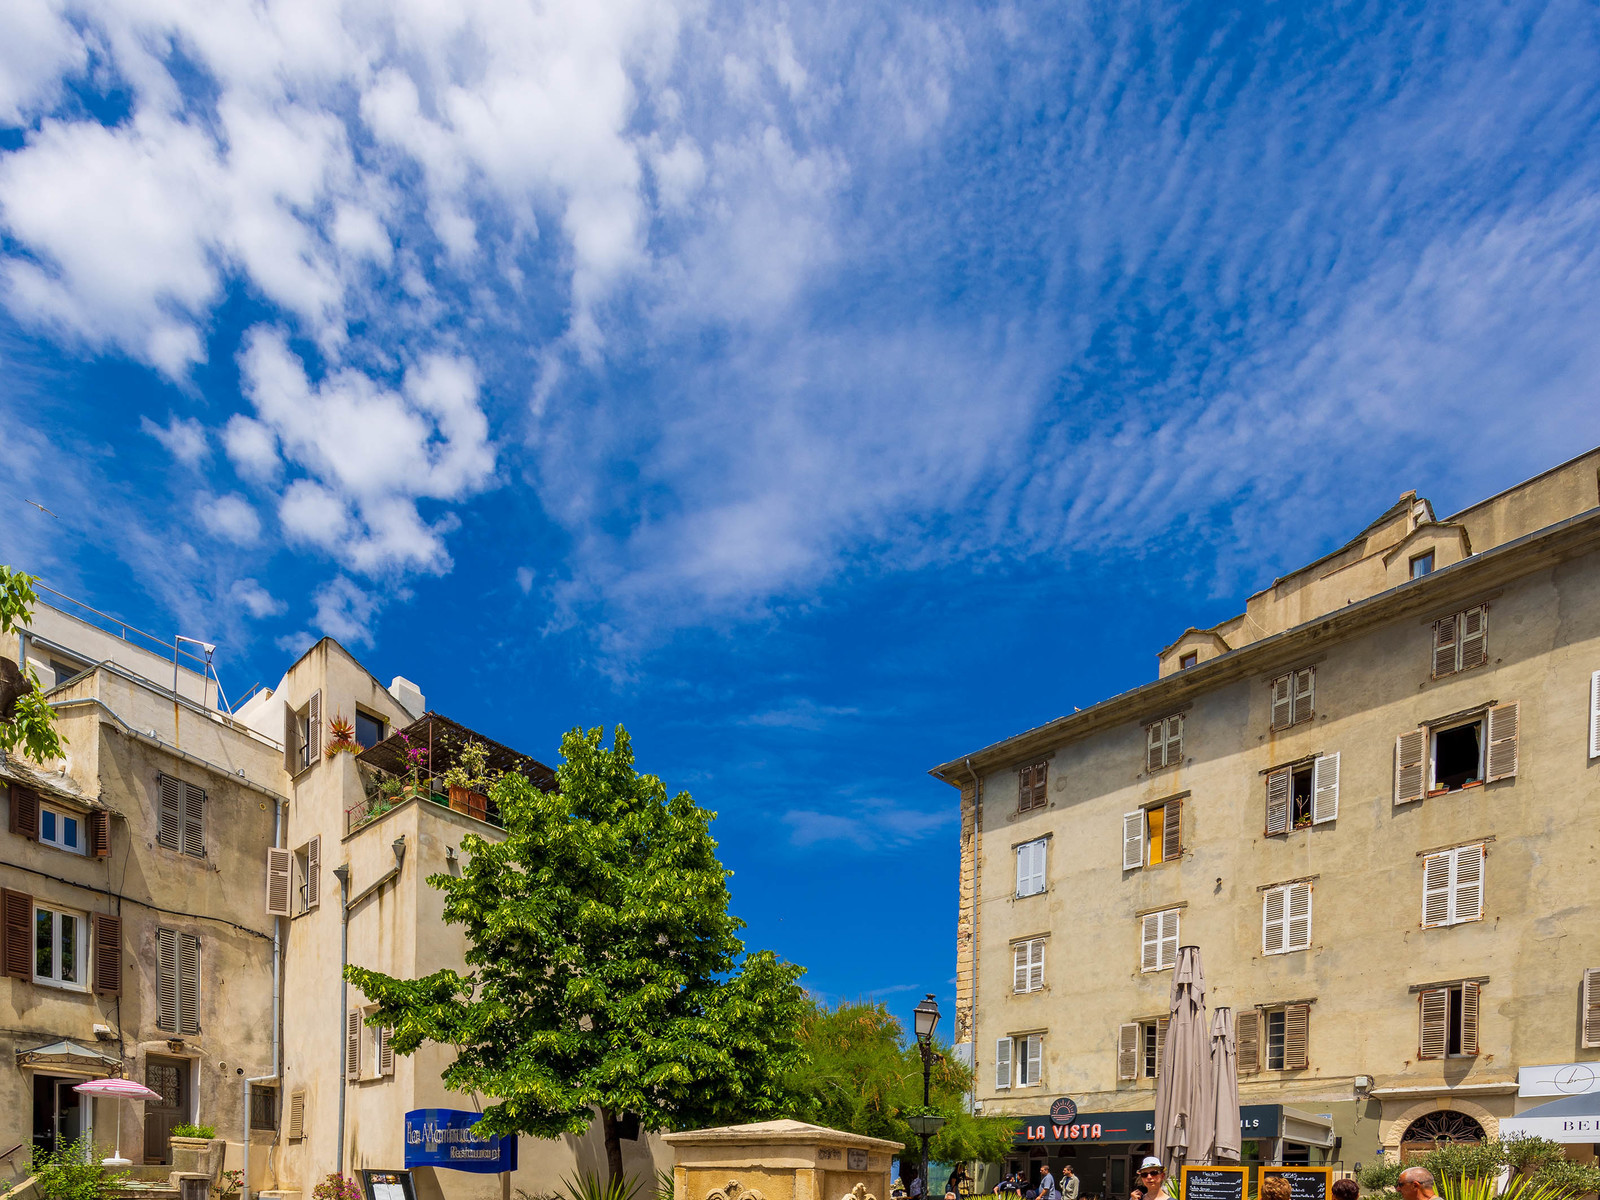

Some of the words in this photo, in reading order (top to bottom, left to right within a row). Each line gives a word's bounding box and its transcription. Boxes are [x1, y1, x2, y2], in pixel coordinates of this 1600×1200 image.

[406, 1121, 422, 1144] La
[1027, 1125, 1046, 1140] LA
[1052, 1123, 1102, 1139] VISTA
[450, 1145, 501, 1159] Restaurant
